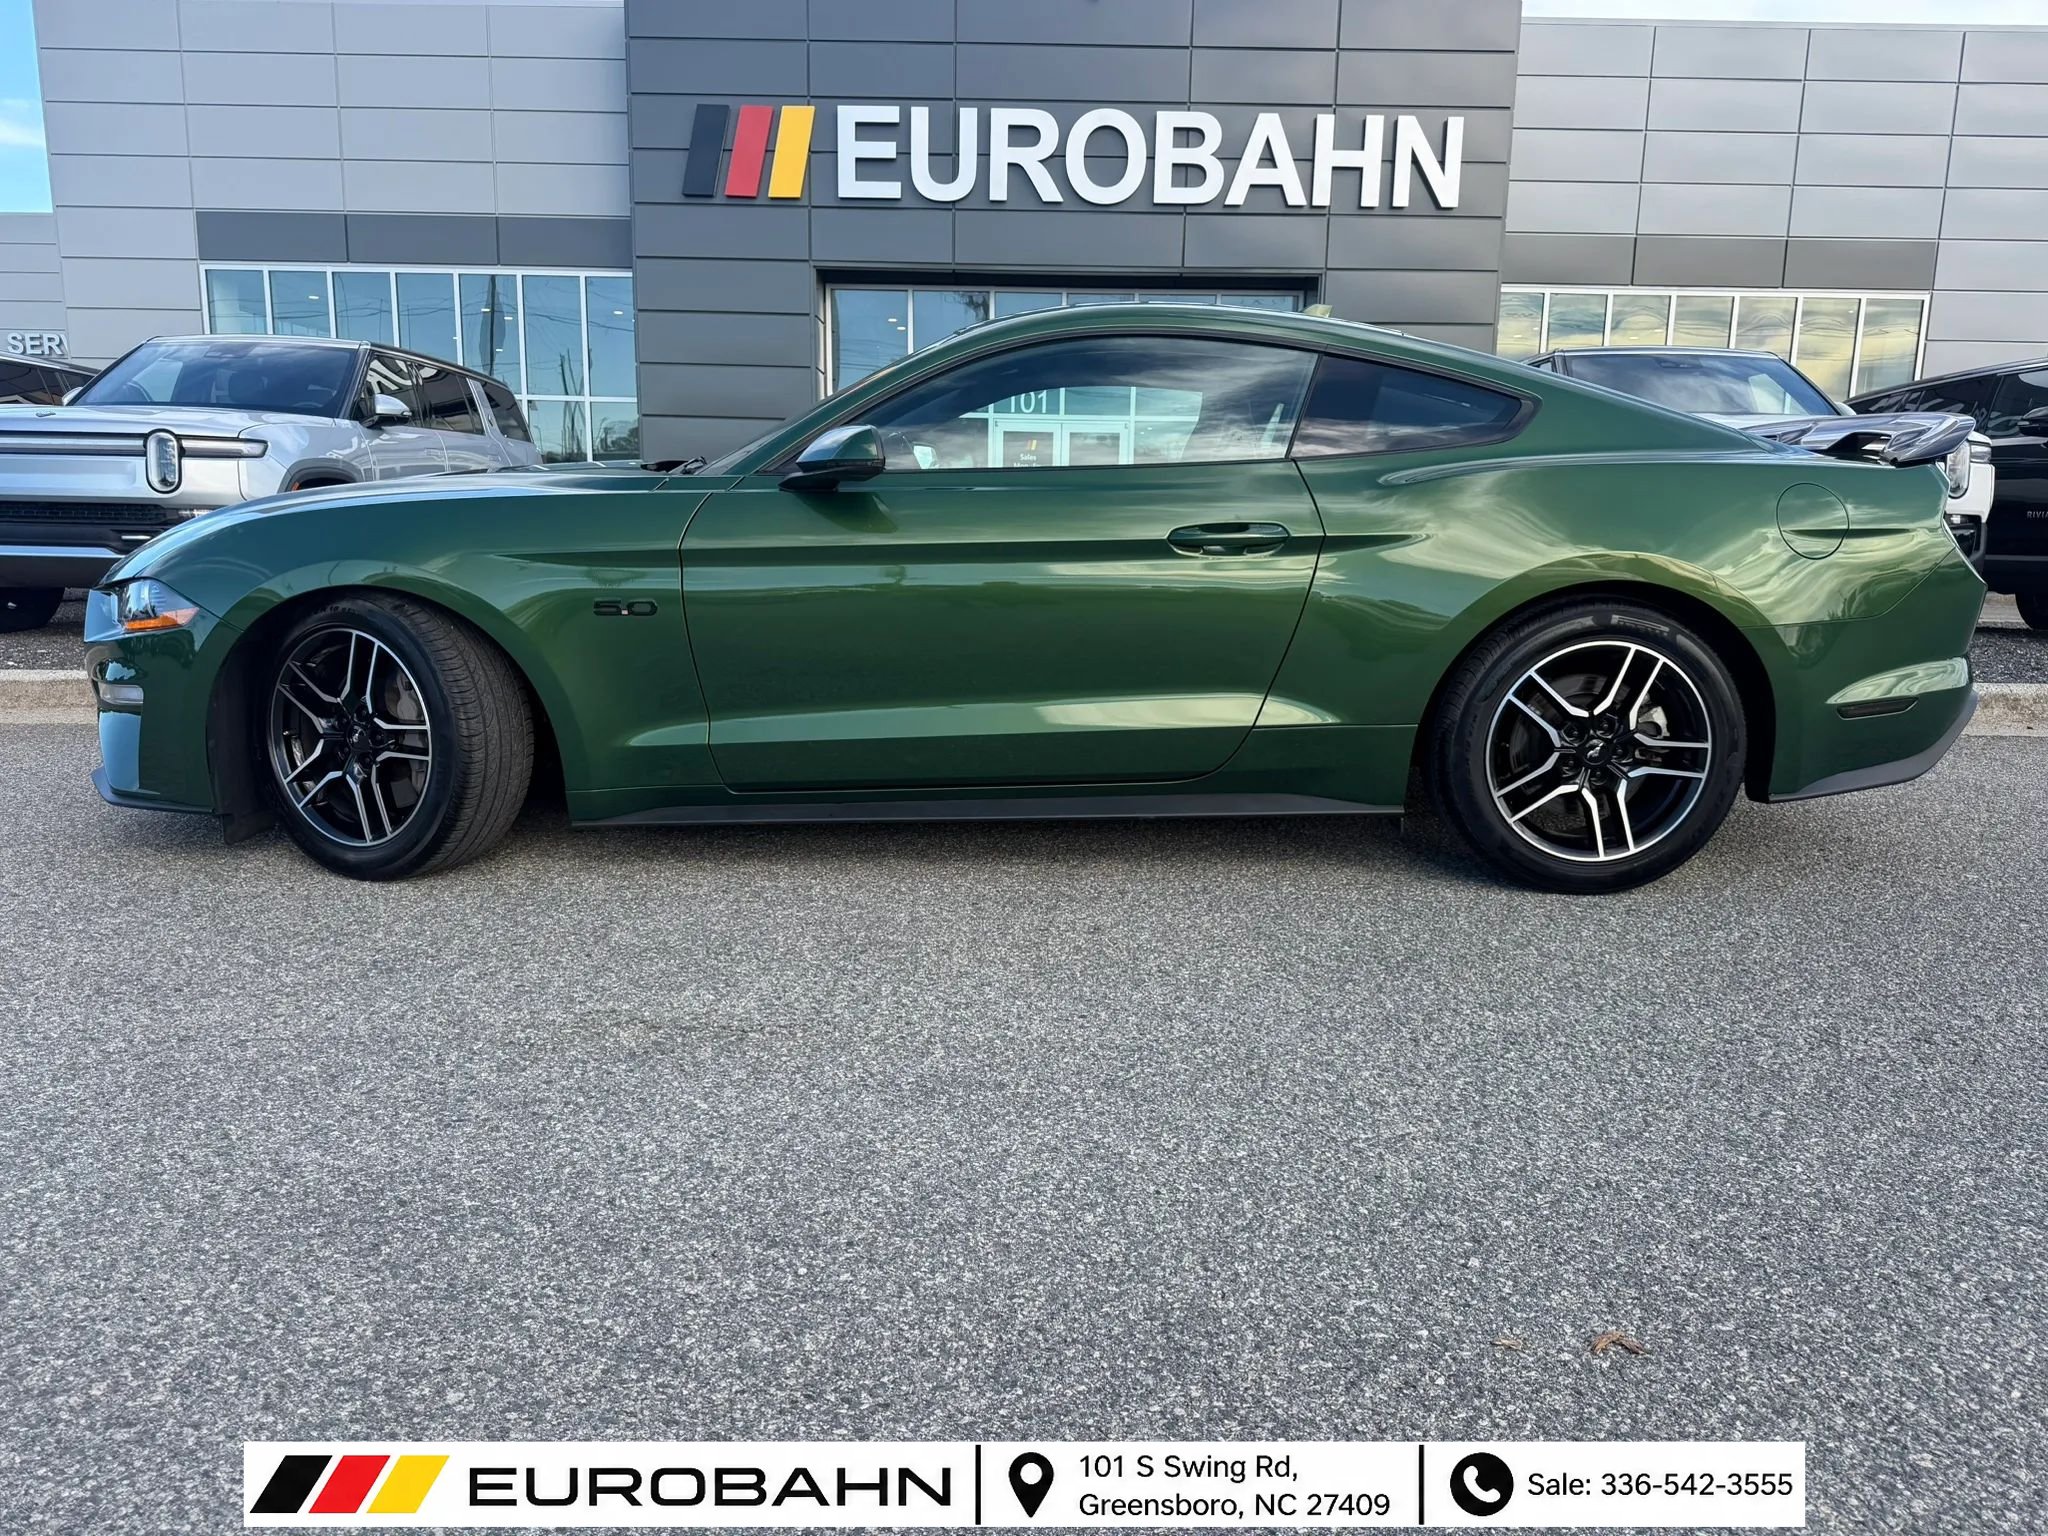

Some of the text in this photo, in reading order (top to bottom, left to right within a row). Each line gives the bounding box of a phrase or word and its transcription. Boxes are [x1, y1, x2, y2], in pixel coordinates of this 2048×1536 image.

[836, 104, 1466, 209] EUROBAHN
[1010, 389, 1047, 414] 101
[593, 599, 659, 616] 5.0
